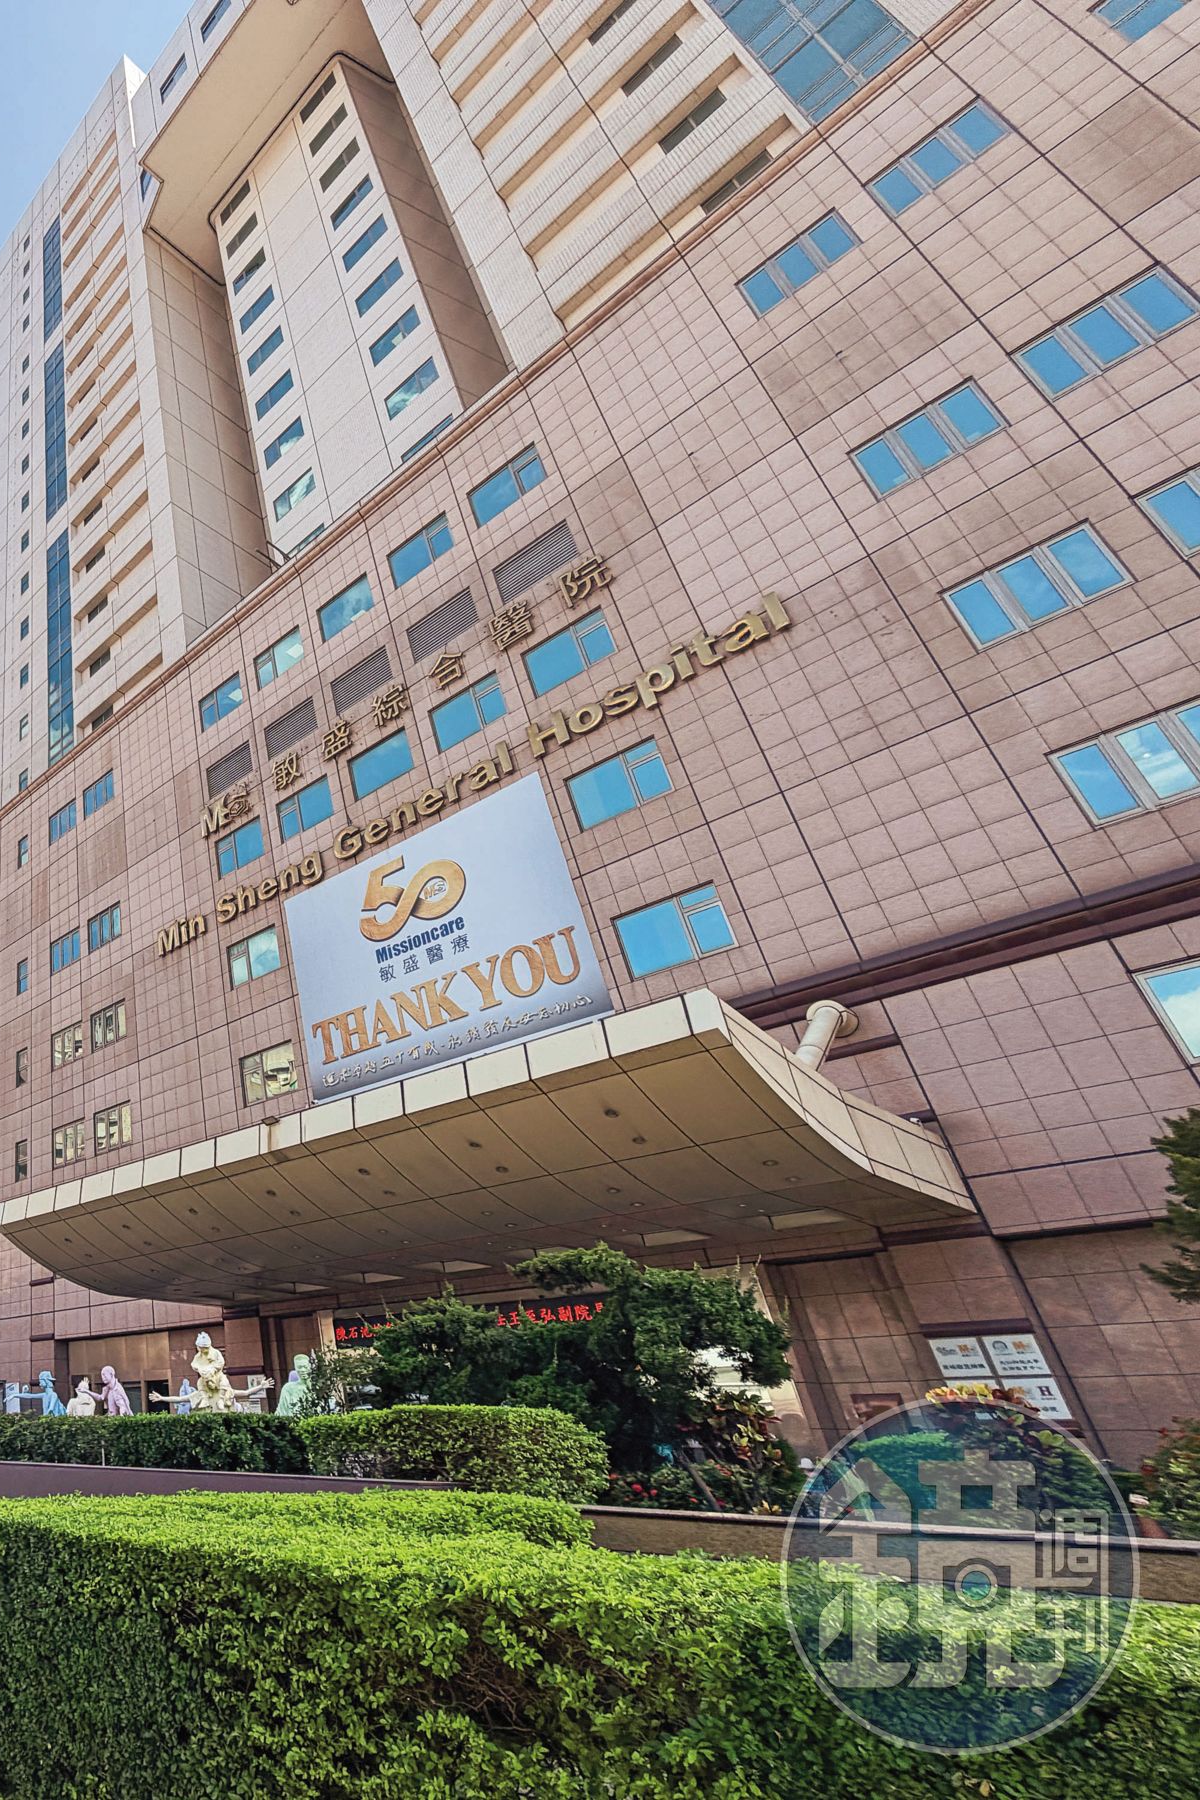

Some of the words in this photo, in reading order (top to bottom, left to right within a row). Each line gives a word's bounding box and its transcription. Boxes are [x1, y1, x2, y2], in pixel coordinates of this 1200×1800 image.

[271, 554, 614, 791] 敏盛綜合醫院
[157, 913, 207, 957] Min
[215, 850, 325, 924] Sheng
[333, 739, 514, 861] General
[525, 591, 791, 760] Hospital
[359, 855, 467, 942] 50
[375, 916, 466, 964] Missioncare
[311, 970, 469, 1066] THANK
[461, 925, 582, 1011] YOU
[378, 932, 471, 983] 敏盛醫療
